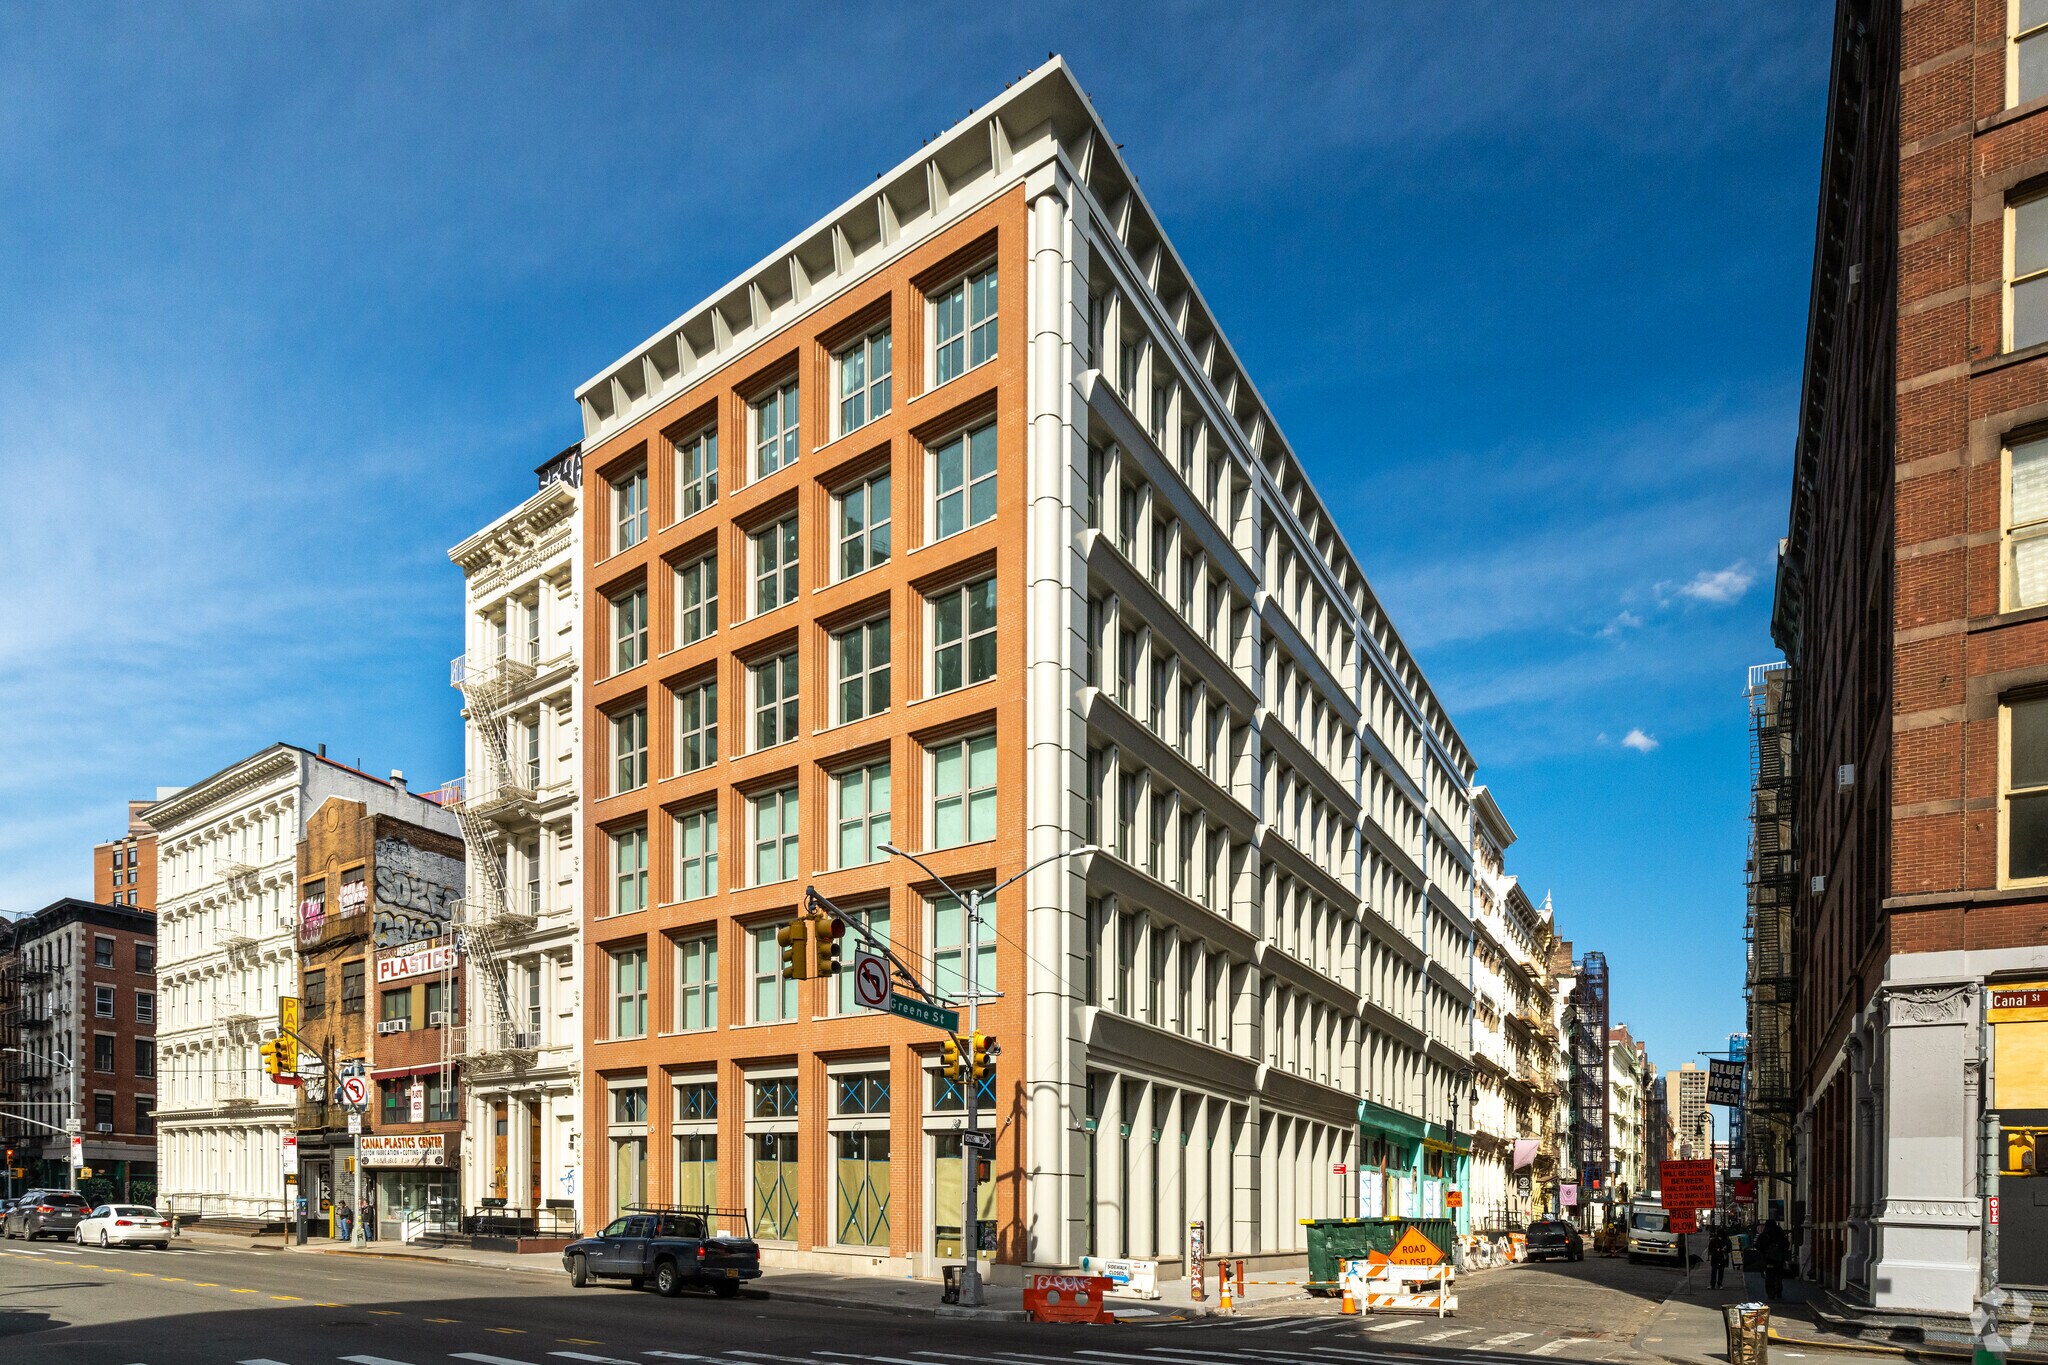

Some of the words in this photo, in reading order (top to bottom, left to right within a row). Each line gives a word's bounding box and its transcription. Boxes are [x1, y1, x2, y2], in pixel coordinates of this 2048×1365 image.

[381, 949, 454, 979] PLASTICS
[1994, 994, 2027, 1007] Canal
[2032, 993, 2040, 1002] St
[890, 997, 929, 1019] Greene
[932, 1012, 945, 1024] St
[1711, 1062, 1743, 1076] BLUE
[1707, 1090, 1739, 1104] REEN
[361, 1137, 383, 1149] CANAL
[384, 1136, 416, 1149] PLASTICS
[418, 1136, 443, 1148] CENTER
[1671, 1210, 1693, 1219] RAISE
[1672, 1222, 1694, 1231] PLOW
[1402, 1244, 1426, 1254] ROAD
[1107, 1263, 1128, 1271] SIDEWALK
[1399, 1258, 1433, 1266] CLOSED
